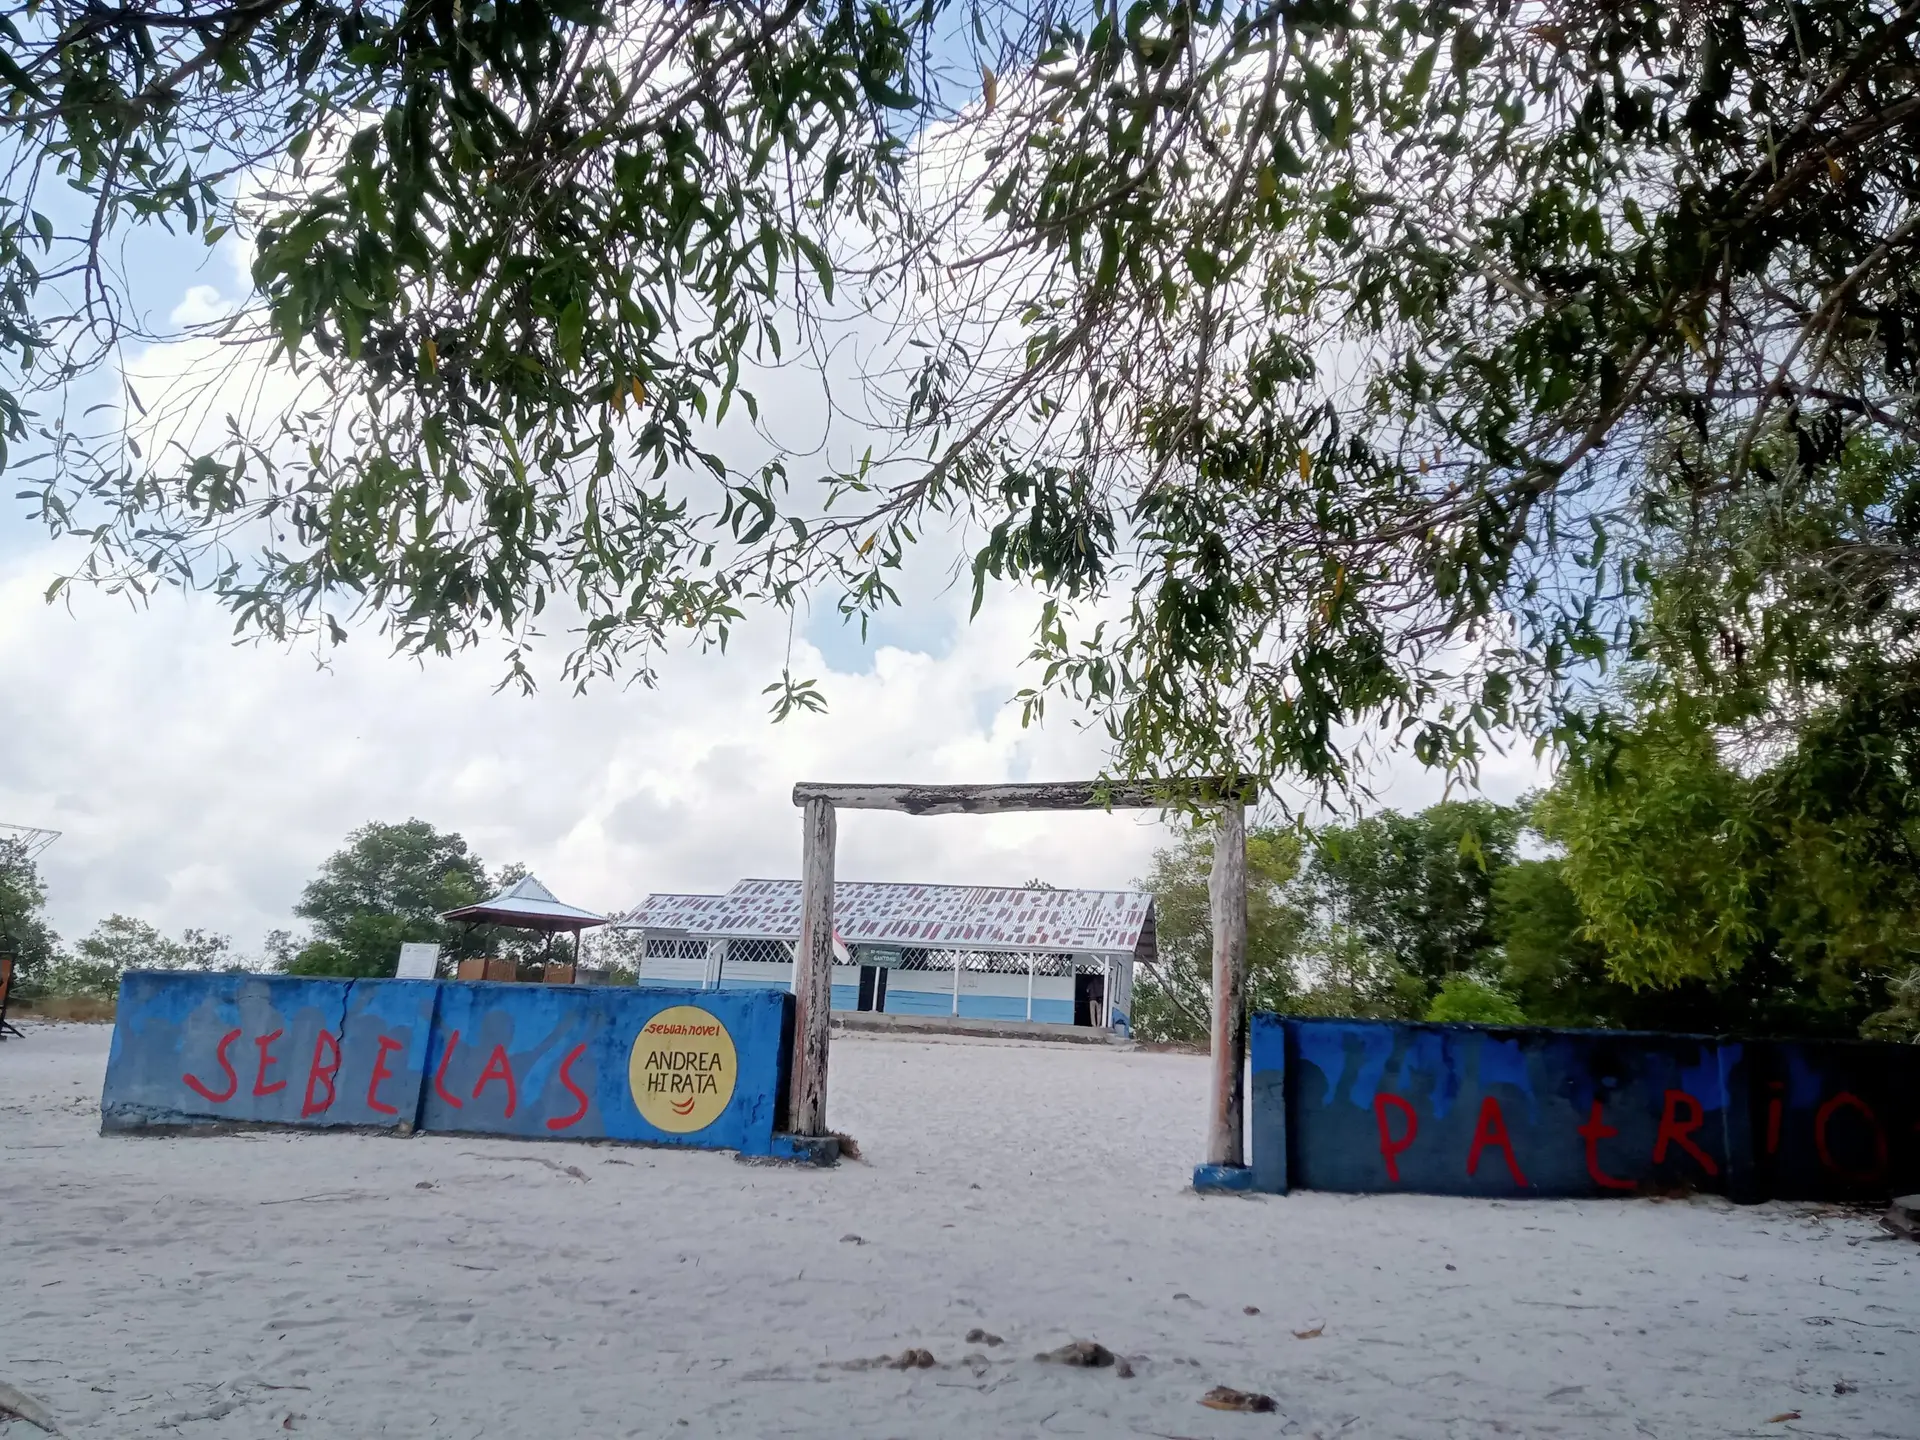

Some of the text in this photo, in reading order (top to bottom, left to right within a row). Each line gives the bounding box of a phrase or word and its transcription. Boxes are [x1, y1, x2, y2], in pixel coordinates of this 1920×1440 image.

[644, 1023, 720, 1037] sebuah novel
[644, 1050, 722, 1072] ANDREA
[182, 1028, 589, 1129] SEBELAS
[647, 1072, 718, 1095] HIRATA
[1373, 1080, 1920, 1189] PAtRiO
